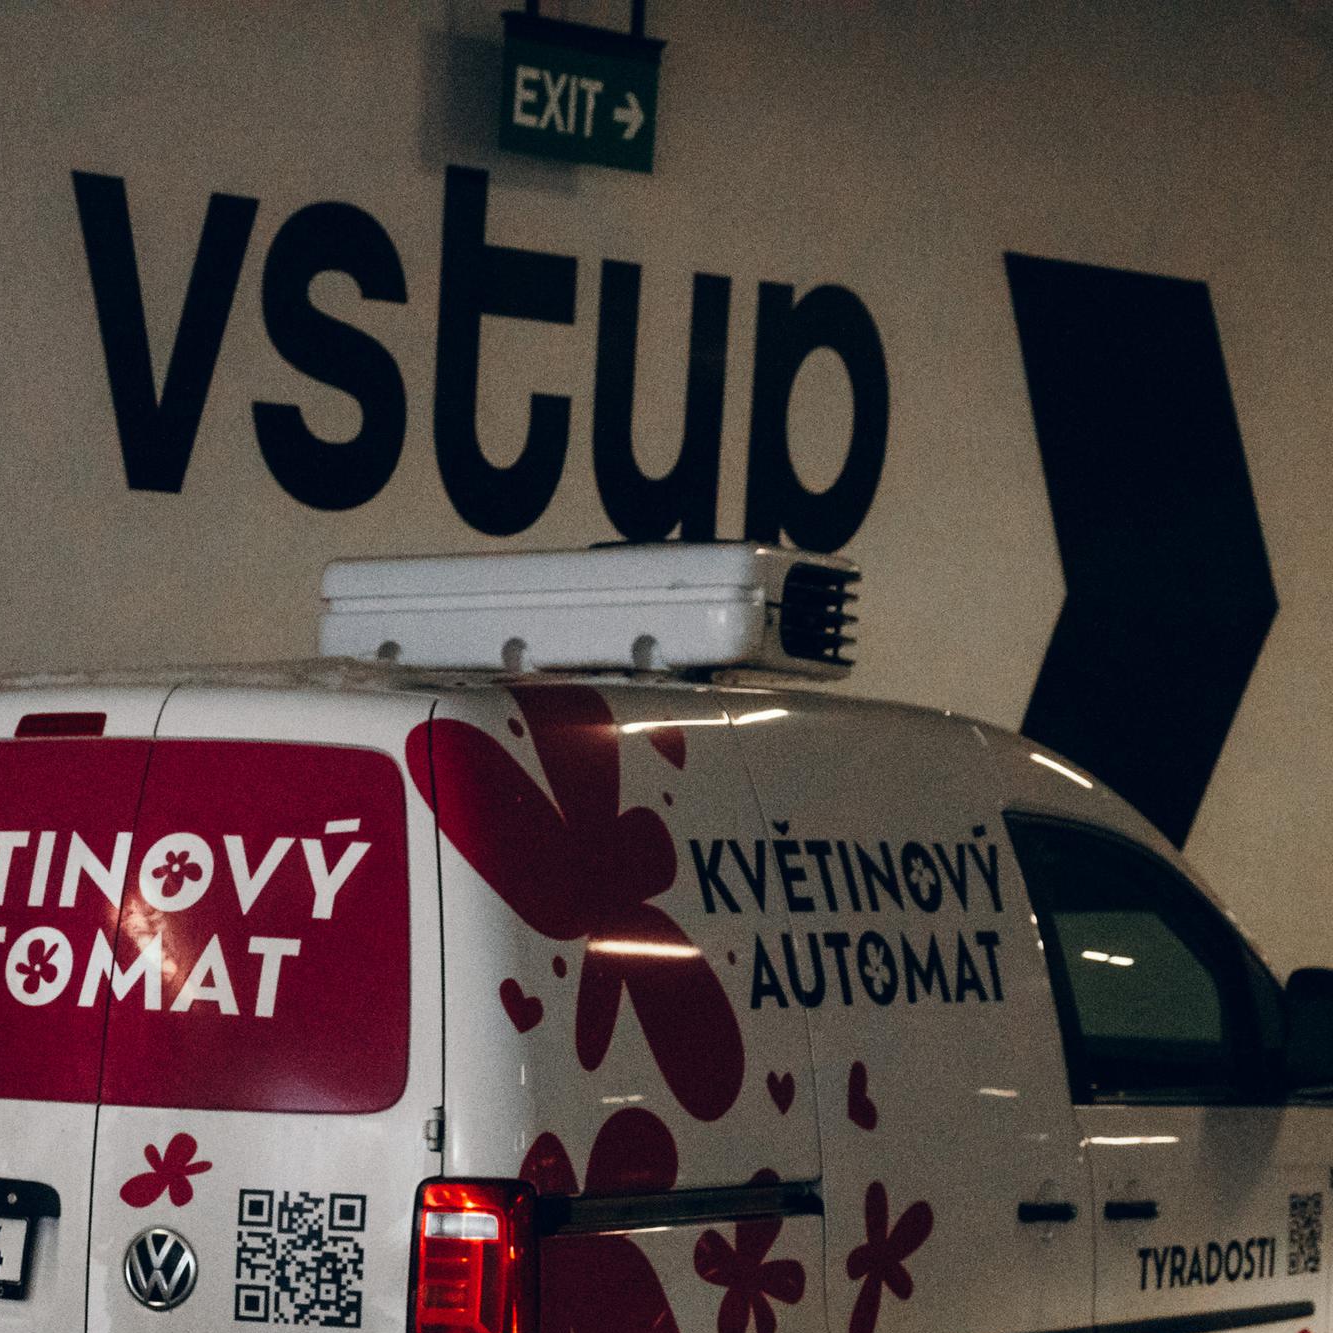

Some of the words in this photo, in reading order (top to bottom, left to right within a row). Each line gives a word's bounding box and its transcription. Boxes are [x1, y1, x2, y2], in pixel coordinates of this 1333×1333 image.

[513, 65, 604, 138] EXIT
[71, 165, 889, 553] vstup
[689, 820, 1004, 914] KVĚTINOVÝ
[750, 931, 1004, 1009] AUTOMAT
[1137, 1237, 1276, 1291] TYRADOSTI
